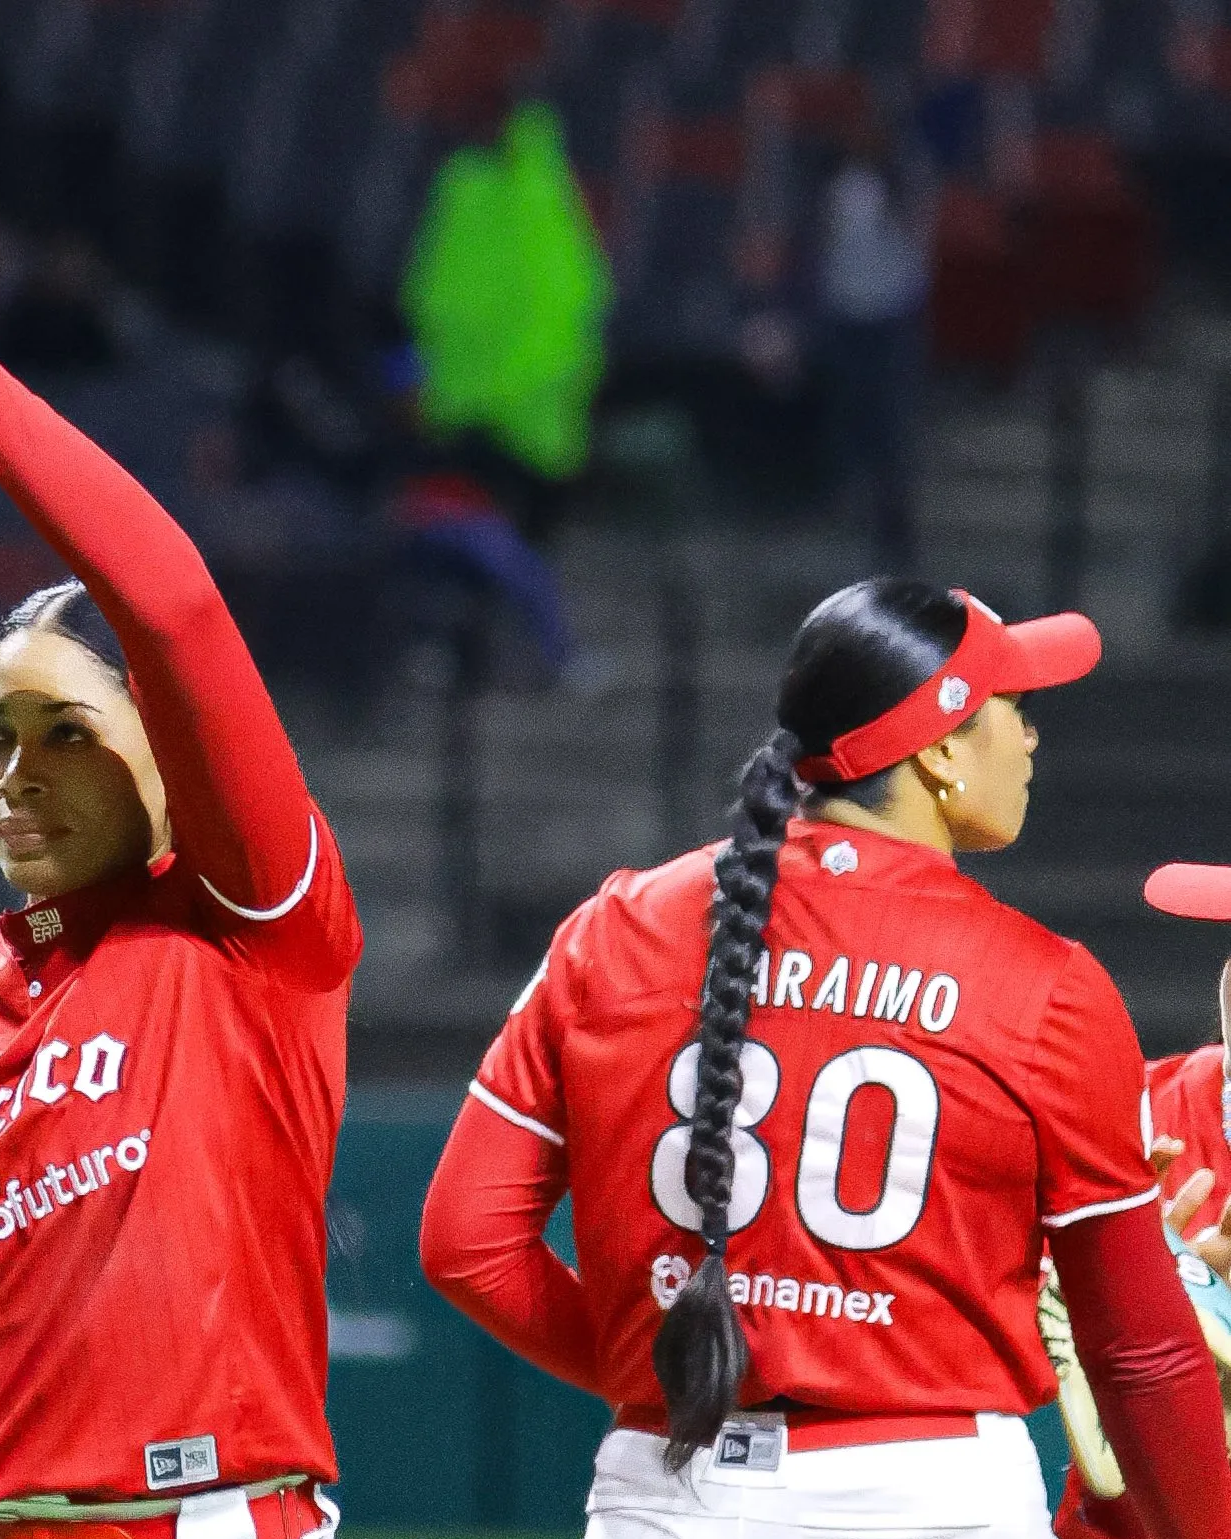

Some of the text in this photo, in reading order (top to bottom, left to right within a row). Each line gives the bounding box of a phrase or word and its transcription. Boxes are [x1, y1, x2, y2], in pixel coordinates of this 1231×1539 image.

[25, 907, 61, 928] NEW
[703, 949, 960, 1033] ARAIMO
[649, 1036, 941, 1252] 80
